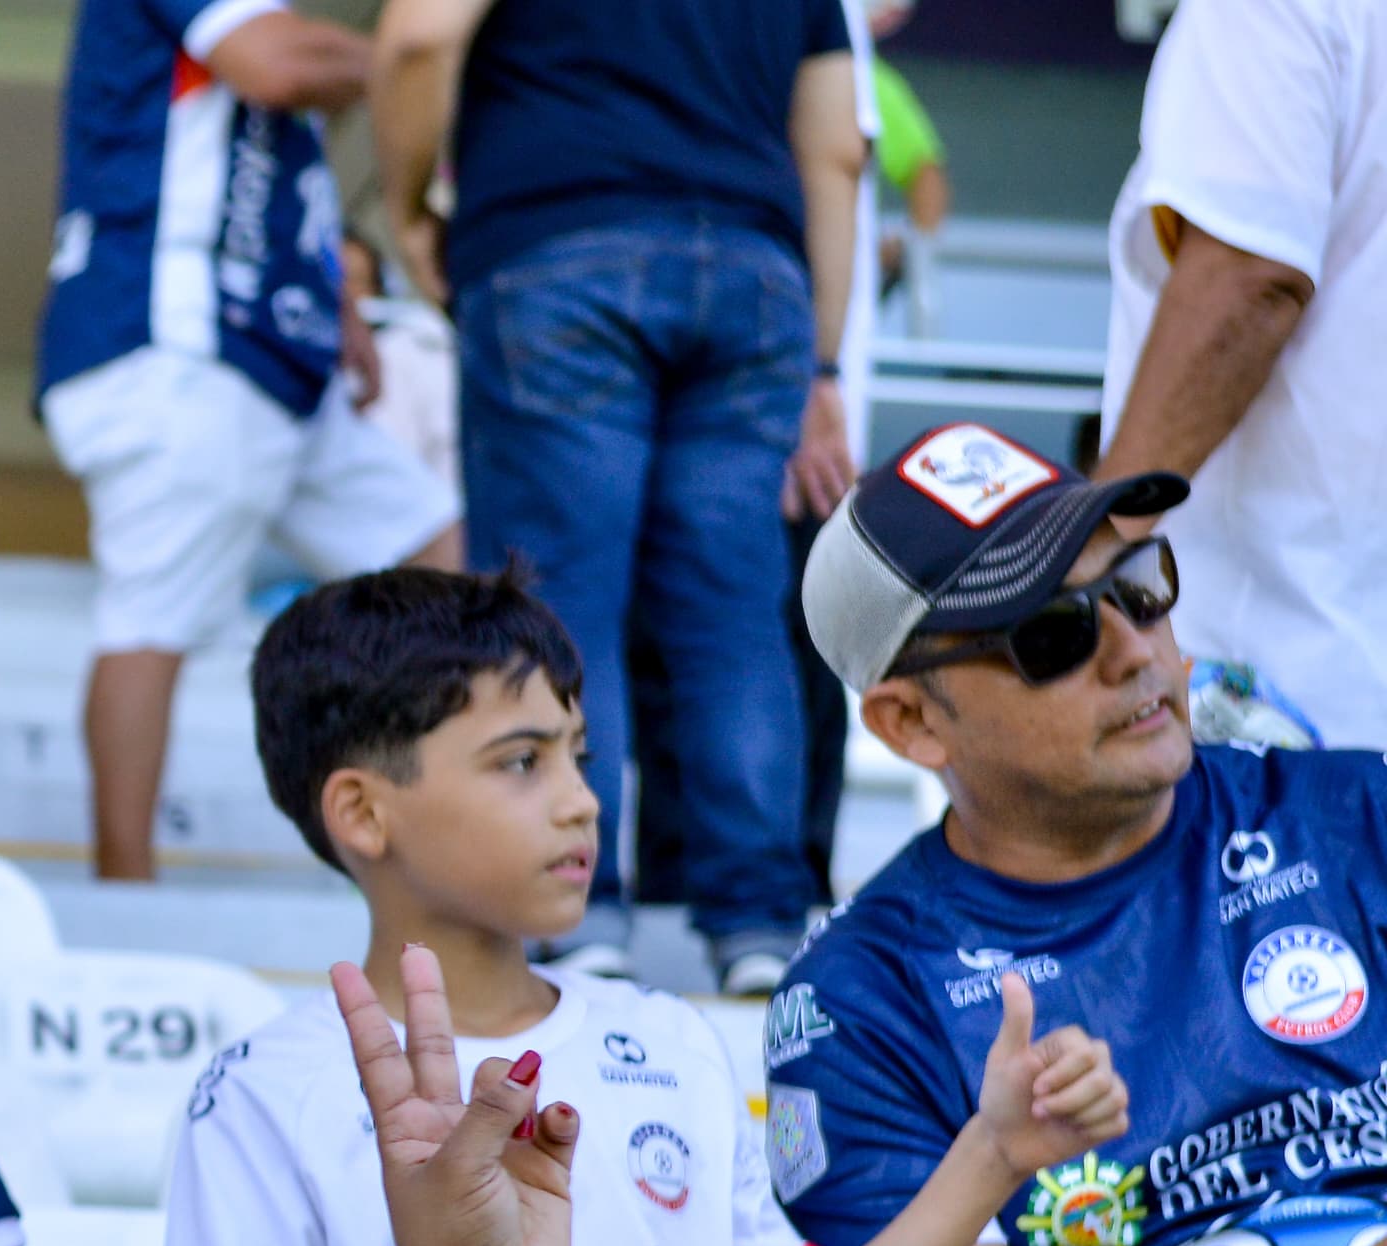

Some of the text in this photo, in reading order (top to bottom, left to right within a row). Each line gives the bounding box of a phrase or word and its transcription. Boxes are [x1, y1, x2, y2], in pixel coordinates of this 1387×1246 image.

[1250, 866, 1320, 907] MATEO
[30, 1001, 198, 1063] N 29
